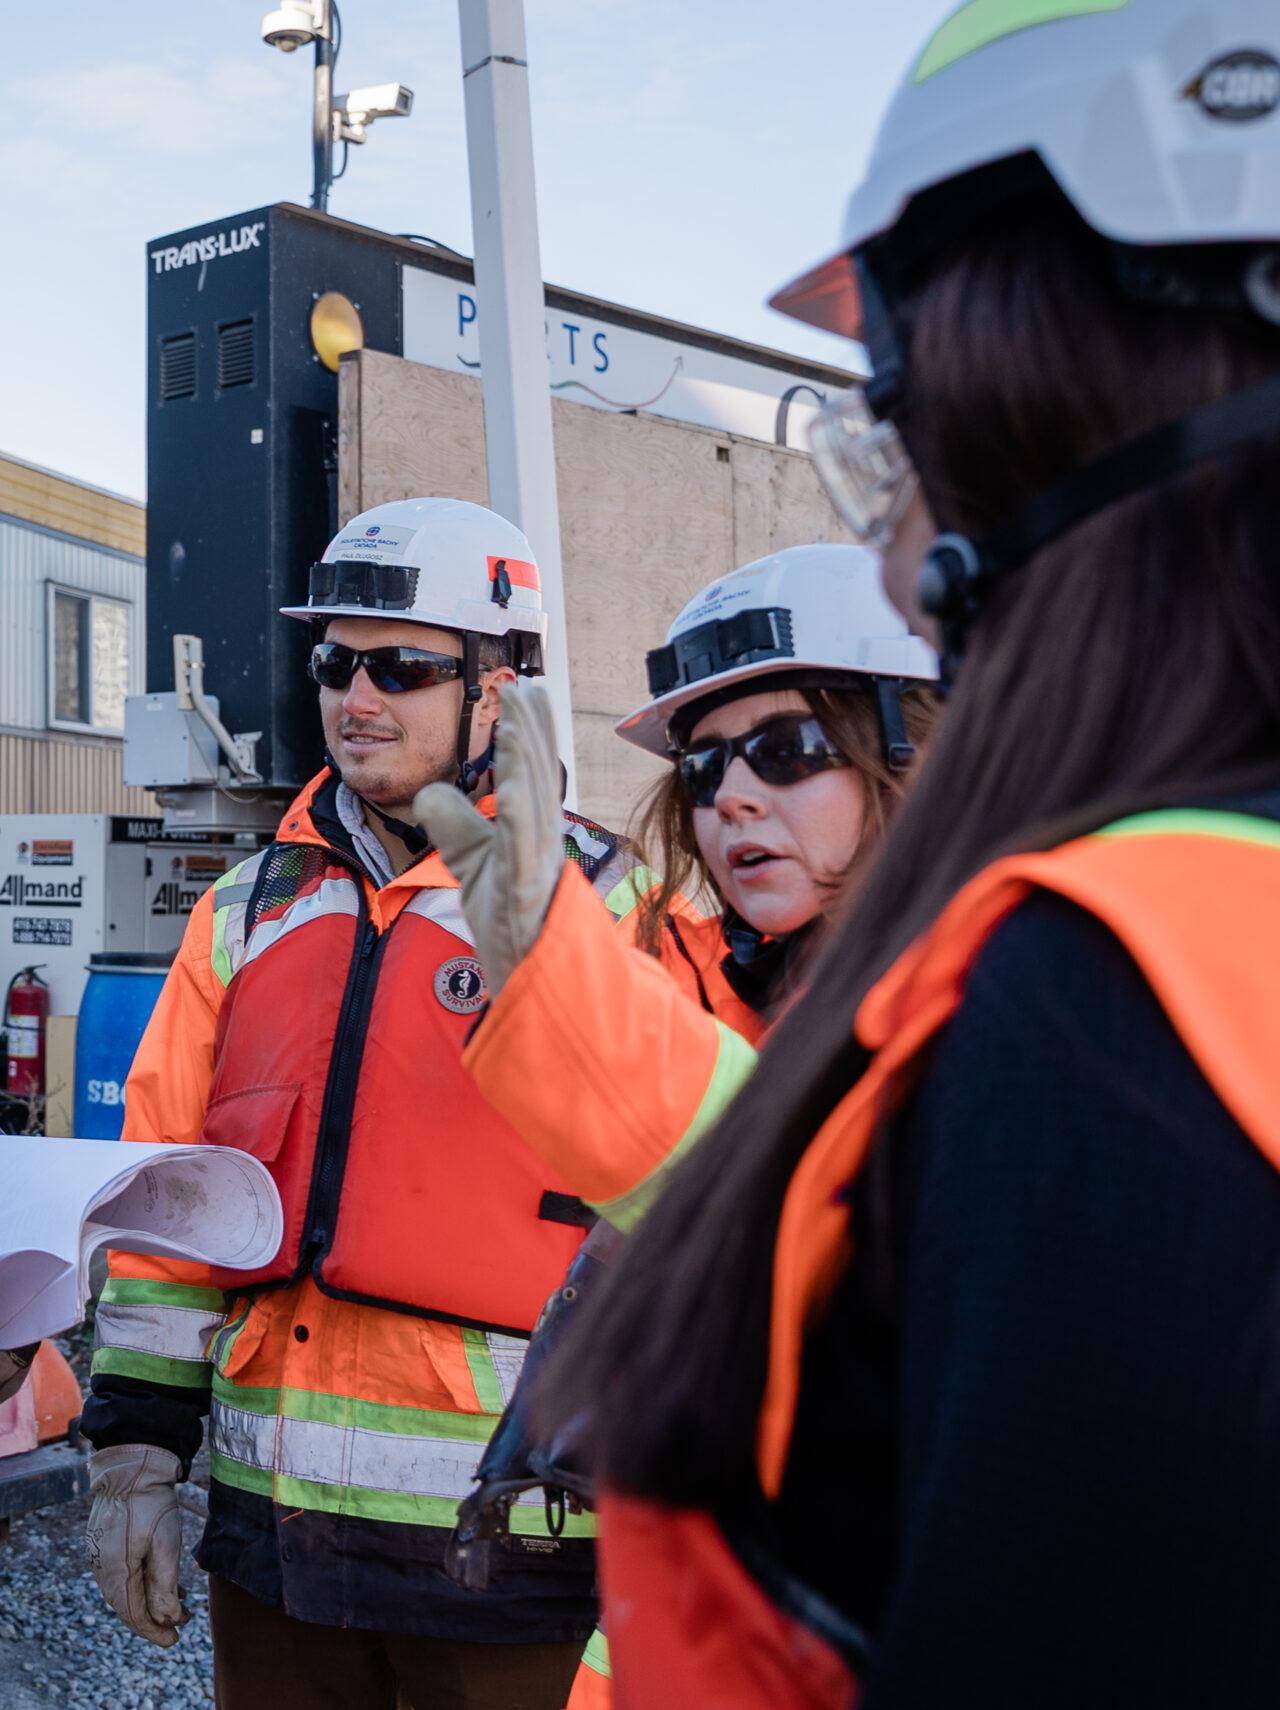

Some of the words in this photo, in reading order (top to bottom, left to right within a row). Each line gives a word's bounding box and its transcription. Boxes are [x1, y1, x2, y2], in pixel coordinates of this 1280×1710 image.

[458, 294, 609, 373] PTS
[151, 883, 207, 915] Allm
[444, 961, 485, 981] MUSTAN
[442, 989, 484, 1007] SURVIVA
